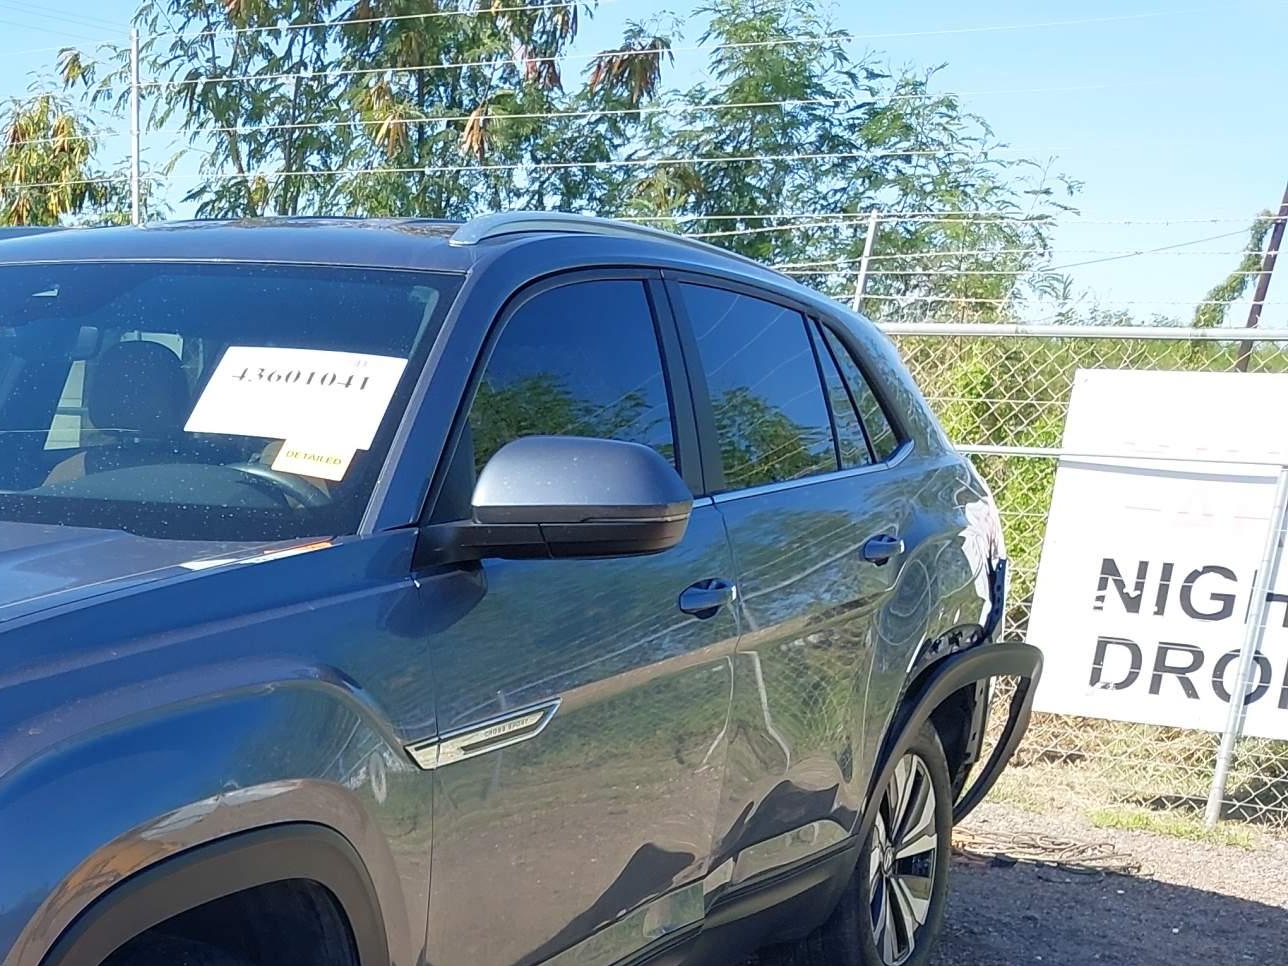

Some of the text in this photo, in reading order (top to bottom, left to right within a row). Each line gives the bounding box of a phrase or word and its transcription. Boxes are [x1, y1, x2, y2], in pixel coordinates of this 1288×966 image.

[232, 367, 370, 391] 43601041
[285, 450, 342, 465] DETAILED
[1088, 635, 1288, 711] DRO
